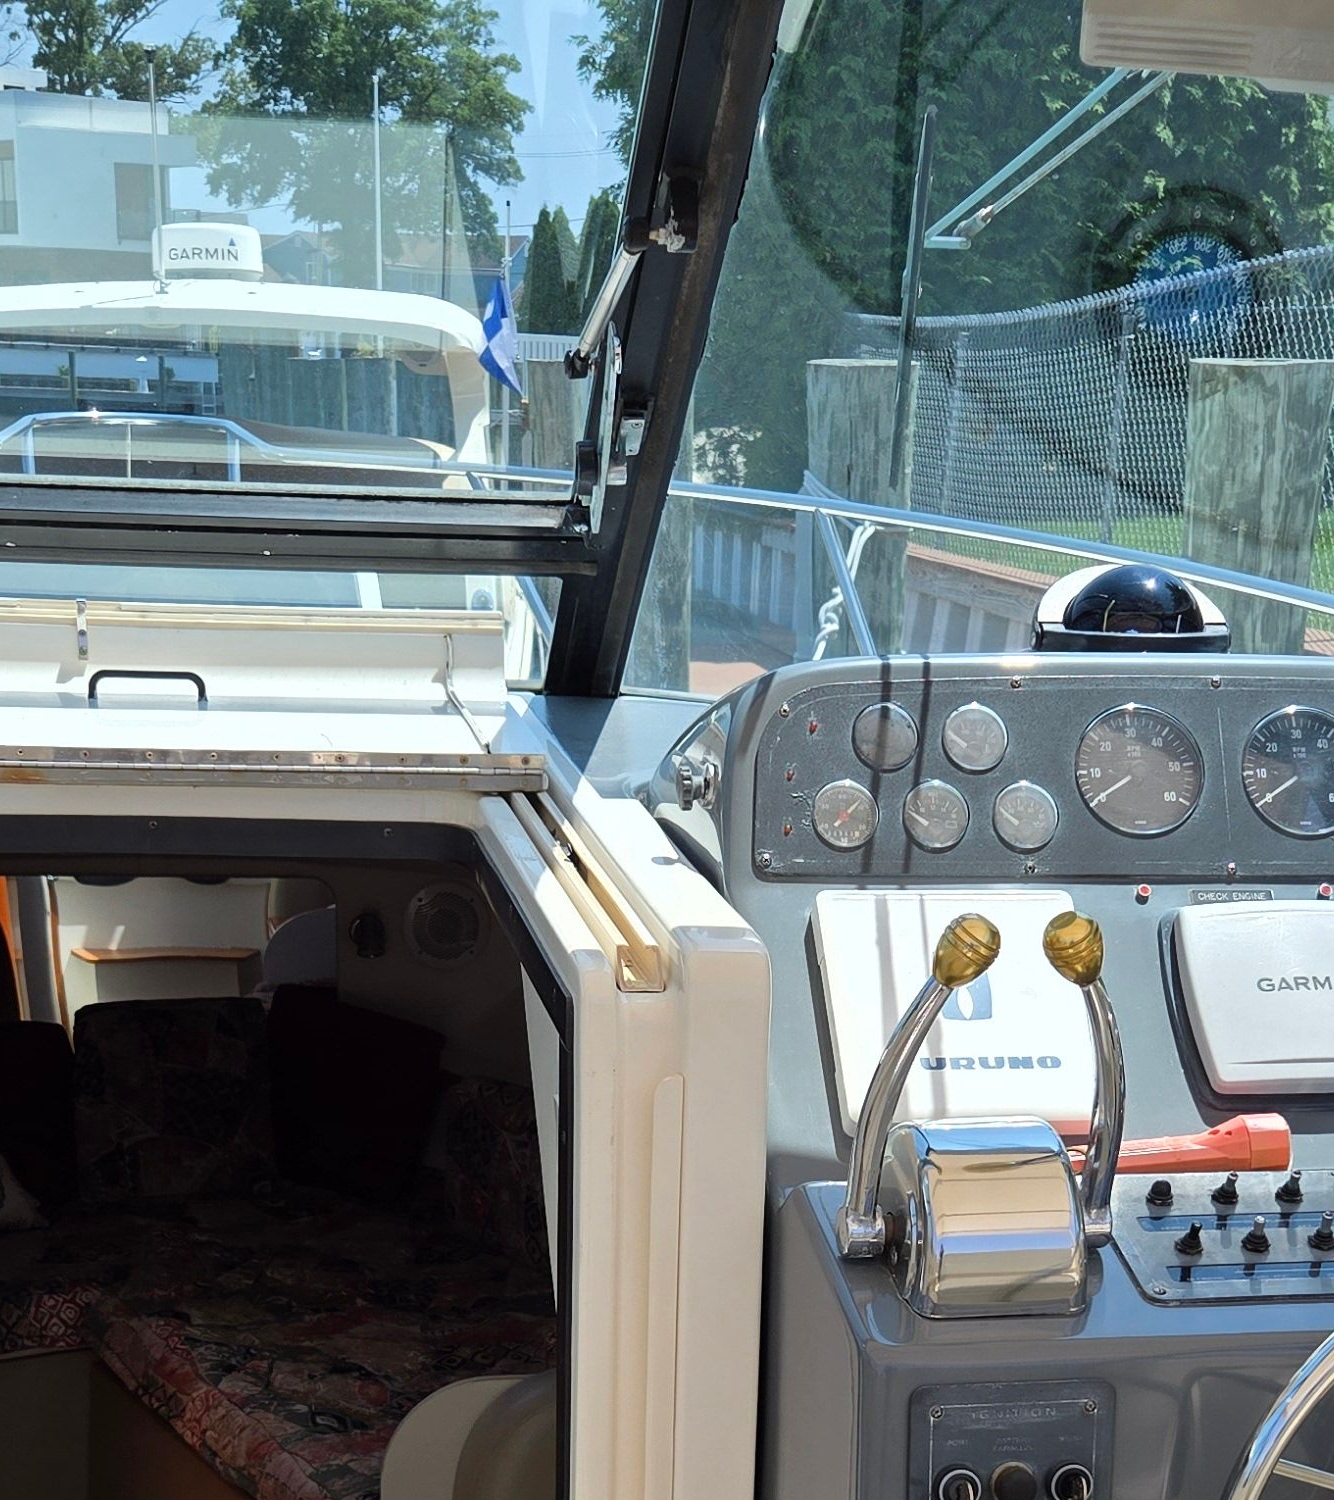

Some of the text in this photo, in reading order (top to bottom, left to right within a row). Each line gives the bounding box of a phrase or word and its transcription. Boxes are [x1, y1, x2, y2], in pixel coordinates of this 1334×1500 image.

[168, 247, 239, 261] GARMIN
[1125, 728, 1136, 738] 30
[1291, 729, 1302, 739] 30
[1100, 742, 1111, 752] 20
[1151, 737, 1163, 747] 40
[1317, 739, 1328, 749] 40
[1266, 743, 1277, 752] 20
[1169, 762, 1180, 772] 50
[1090, 768, 1101, 778] 10
[1256, 768, 1267, 778] 10
[1164, 792, 1176, 802] 60
[1198, 892, 1267, 901] CHECK ENGINE
[919, 1056, 1062, 1070] URUNO
